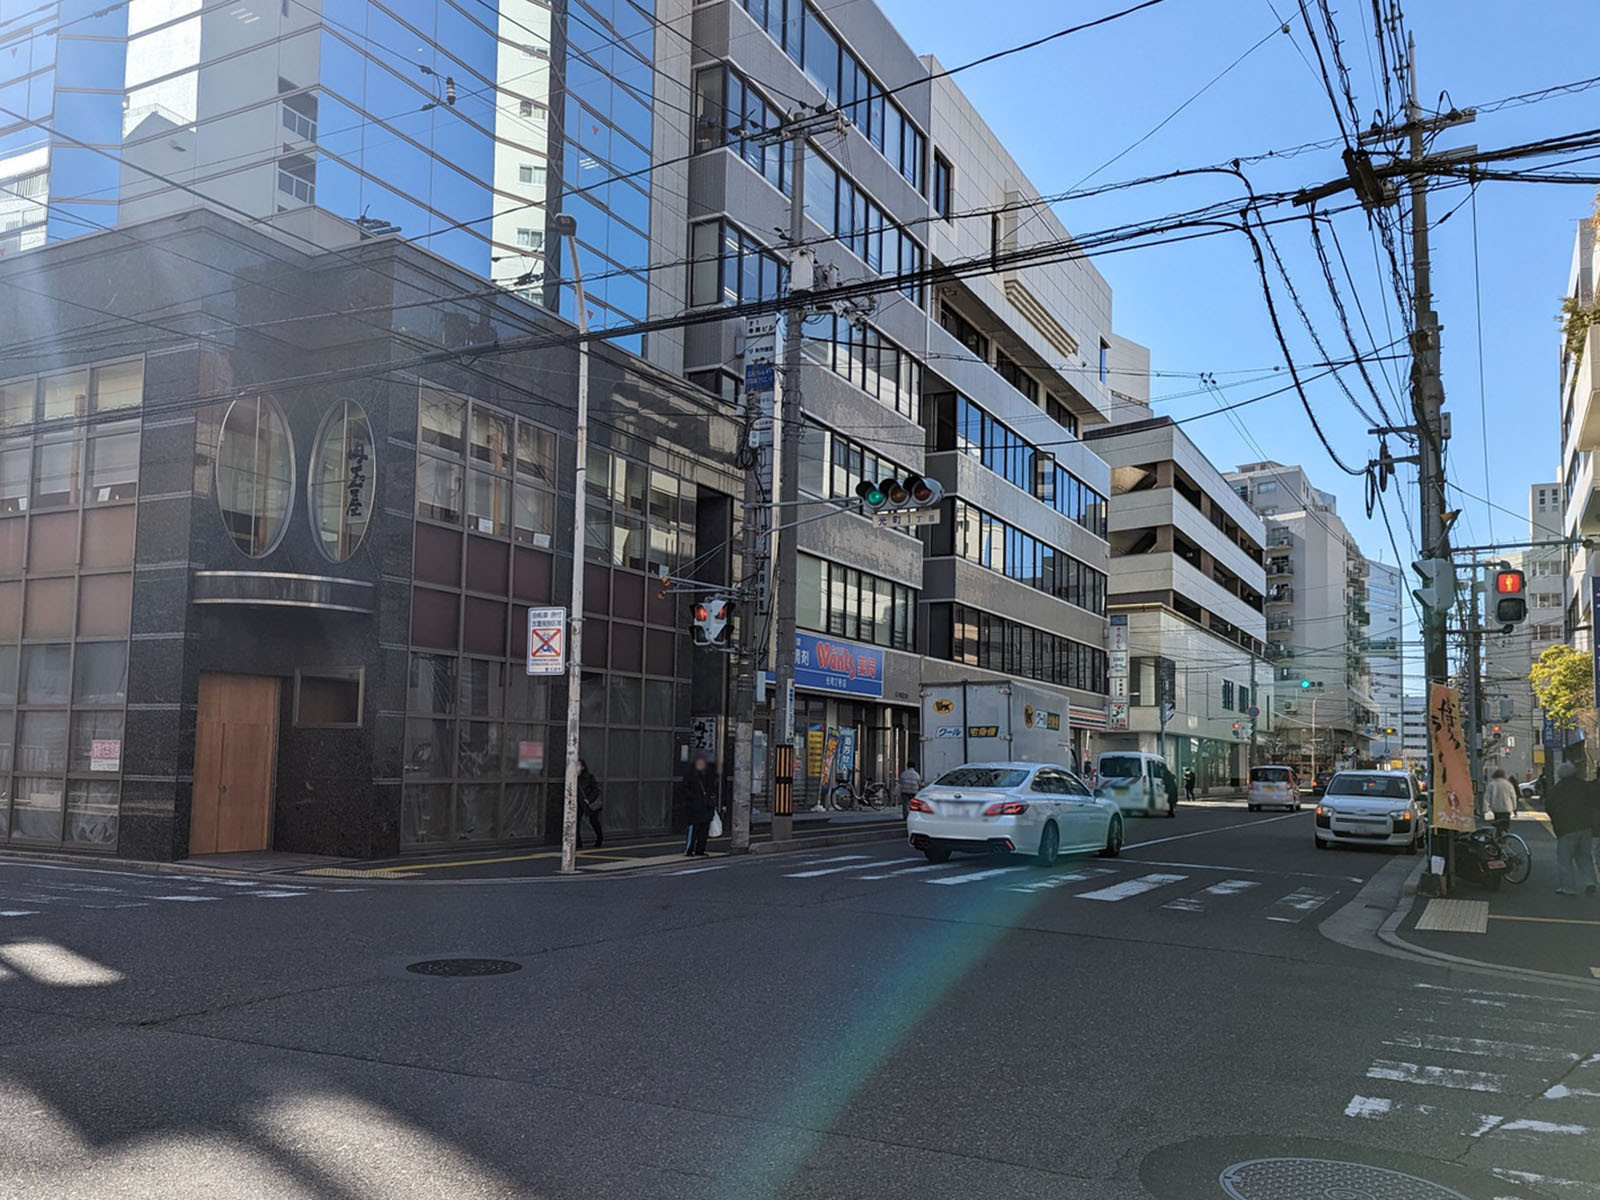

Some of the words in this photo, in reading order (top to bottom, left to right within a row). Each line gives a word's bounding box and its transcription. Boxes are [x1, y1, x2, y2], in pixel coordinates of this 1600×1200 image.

[878, 514, 935, 526] 光町1丁目
[938, 727, 962, 738] クール
